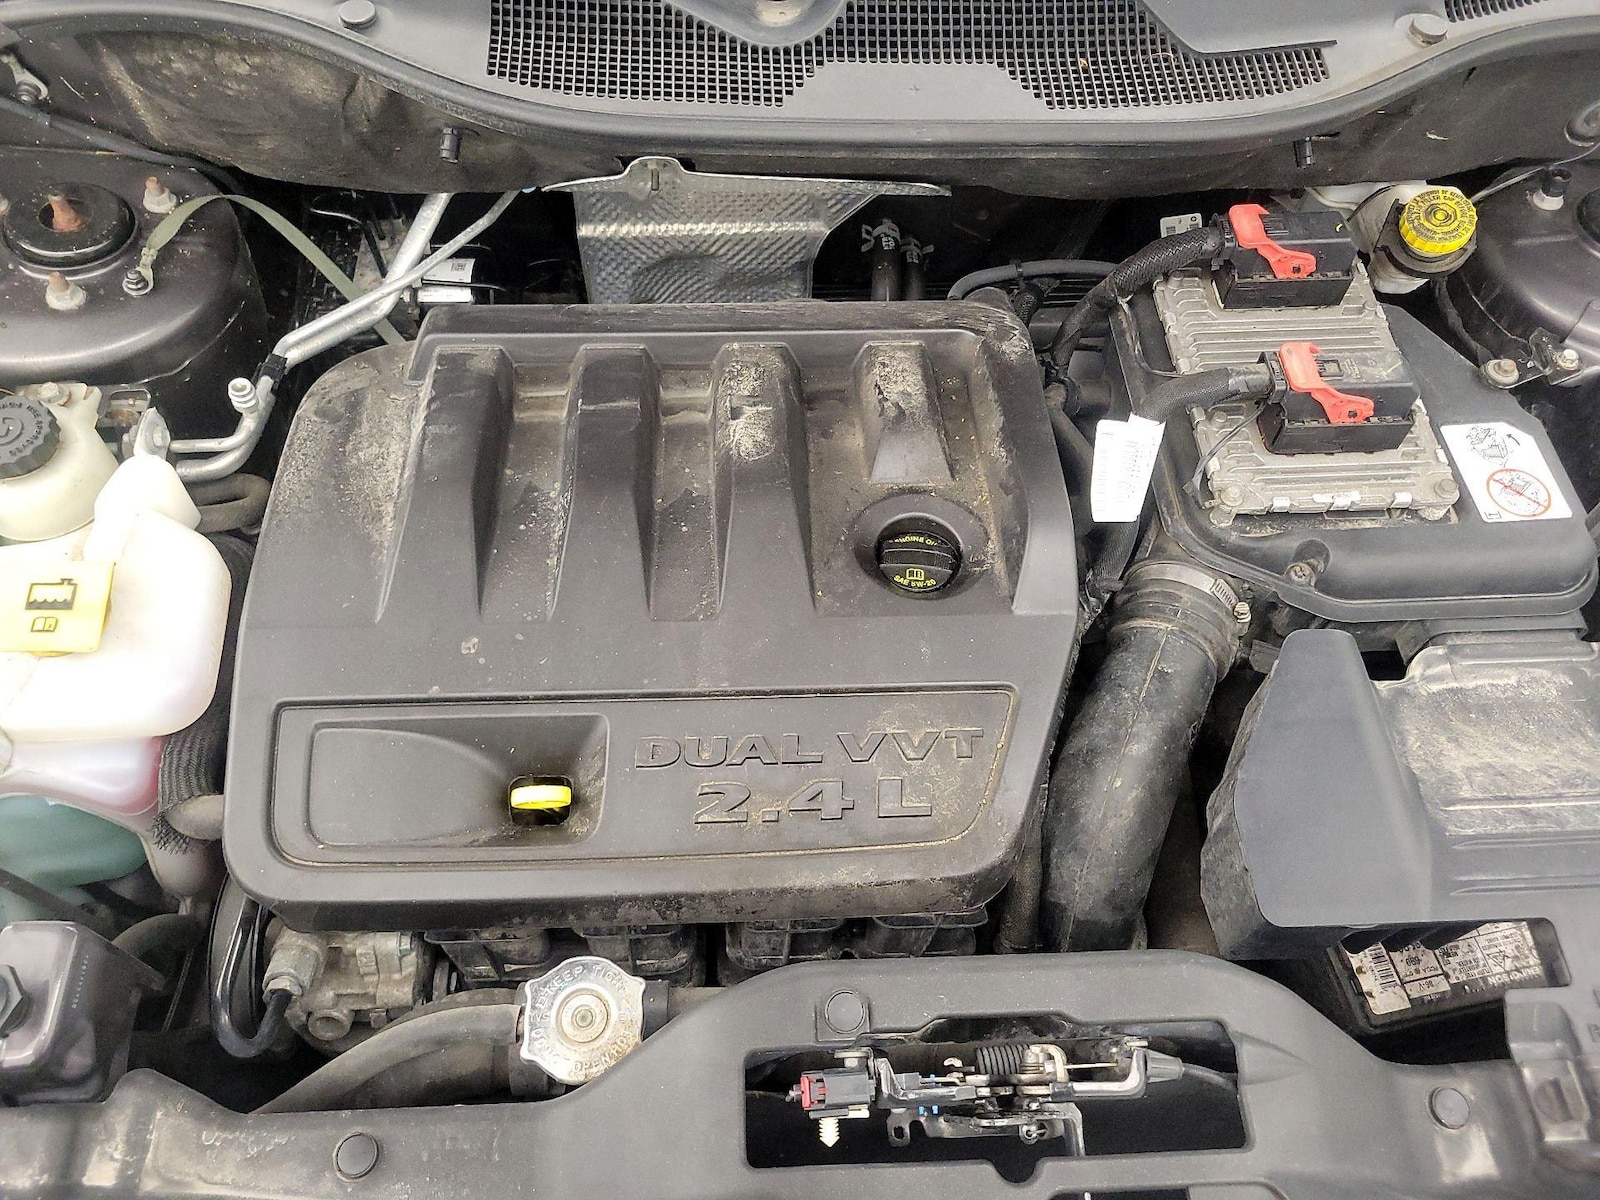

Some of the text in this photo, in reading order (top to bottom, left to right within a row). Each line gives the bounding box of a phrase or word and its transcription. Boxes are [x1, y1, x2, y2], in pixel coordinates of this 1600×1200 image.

[894, 575, 909, 585] SAE
[636, 728, 985, 768] DUAL VVT
[547, 965, 626, 995] KEEP TIGHT
